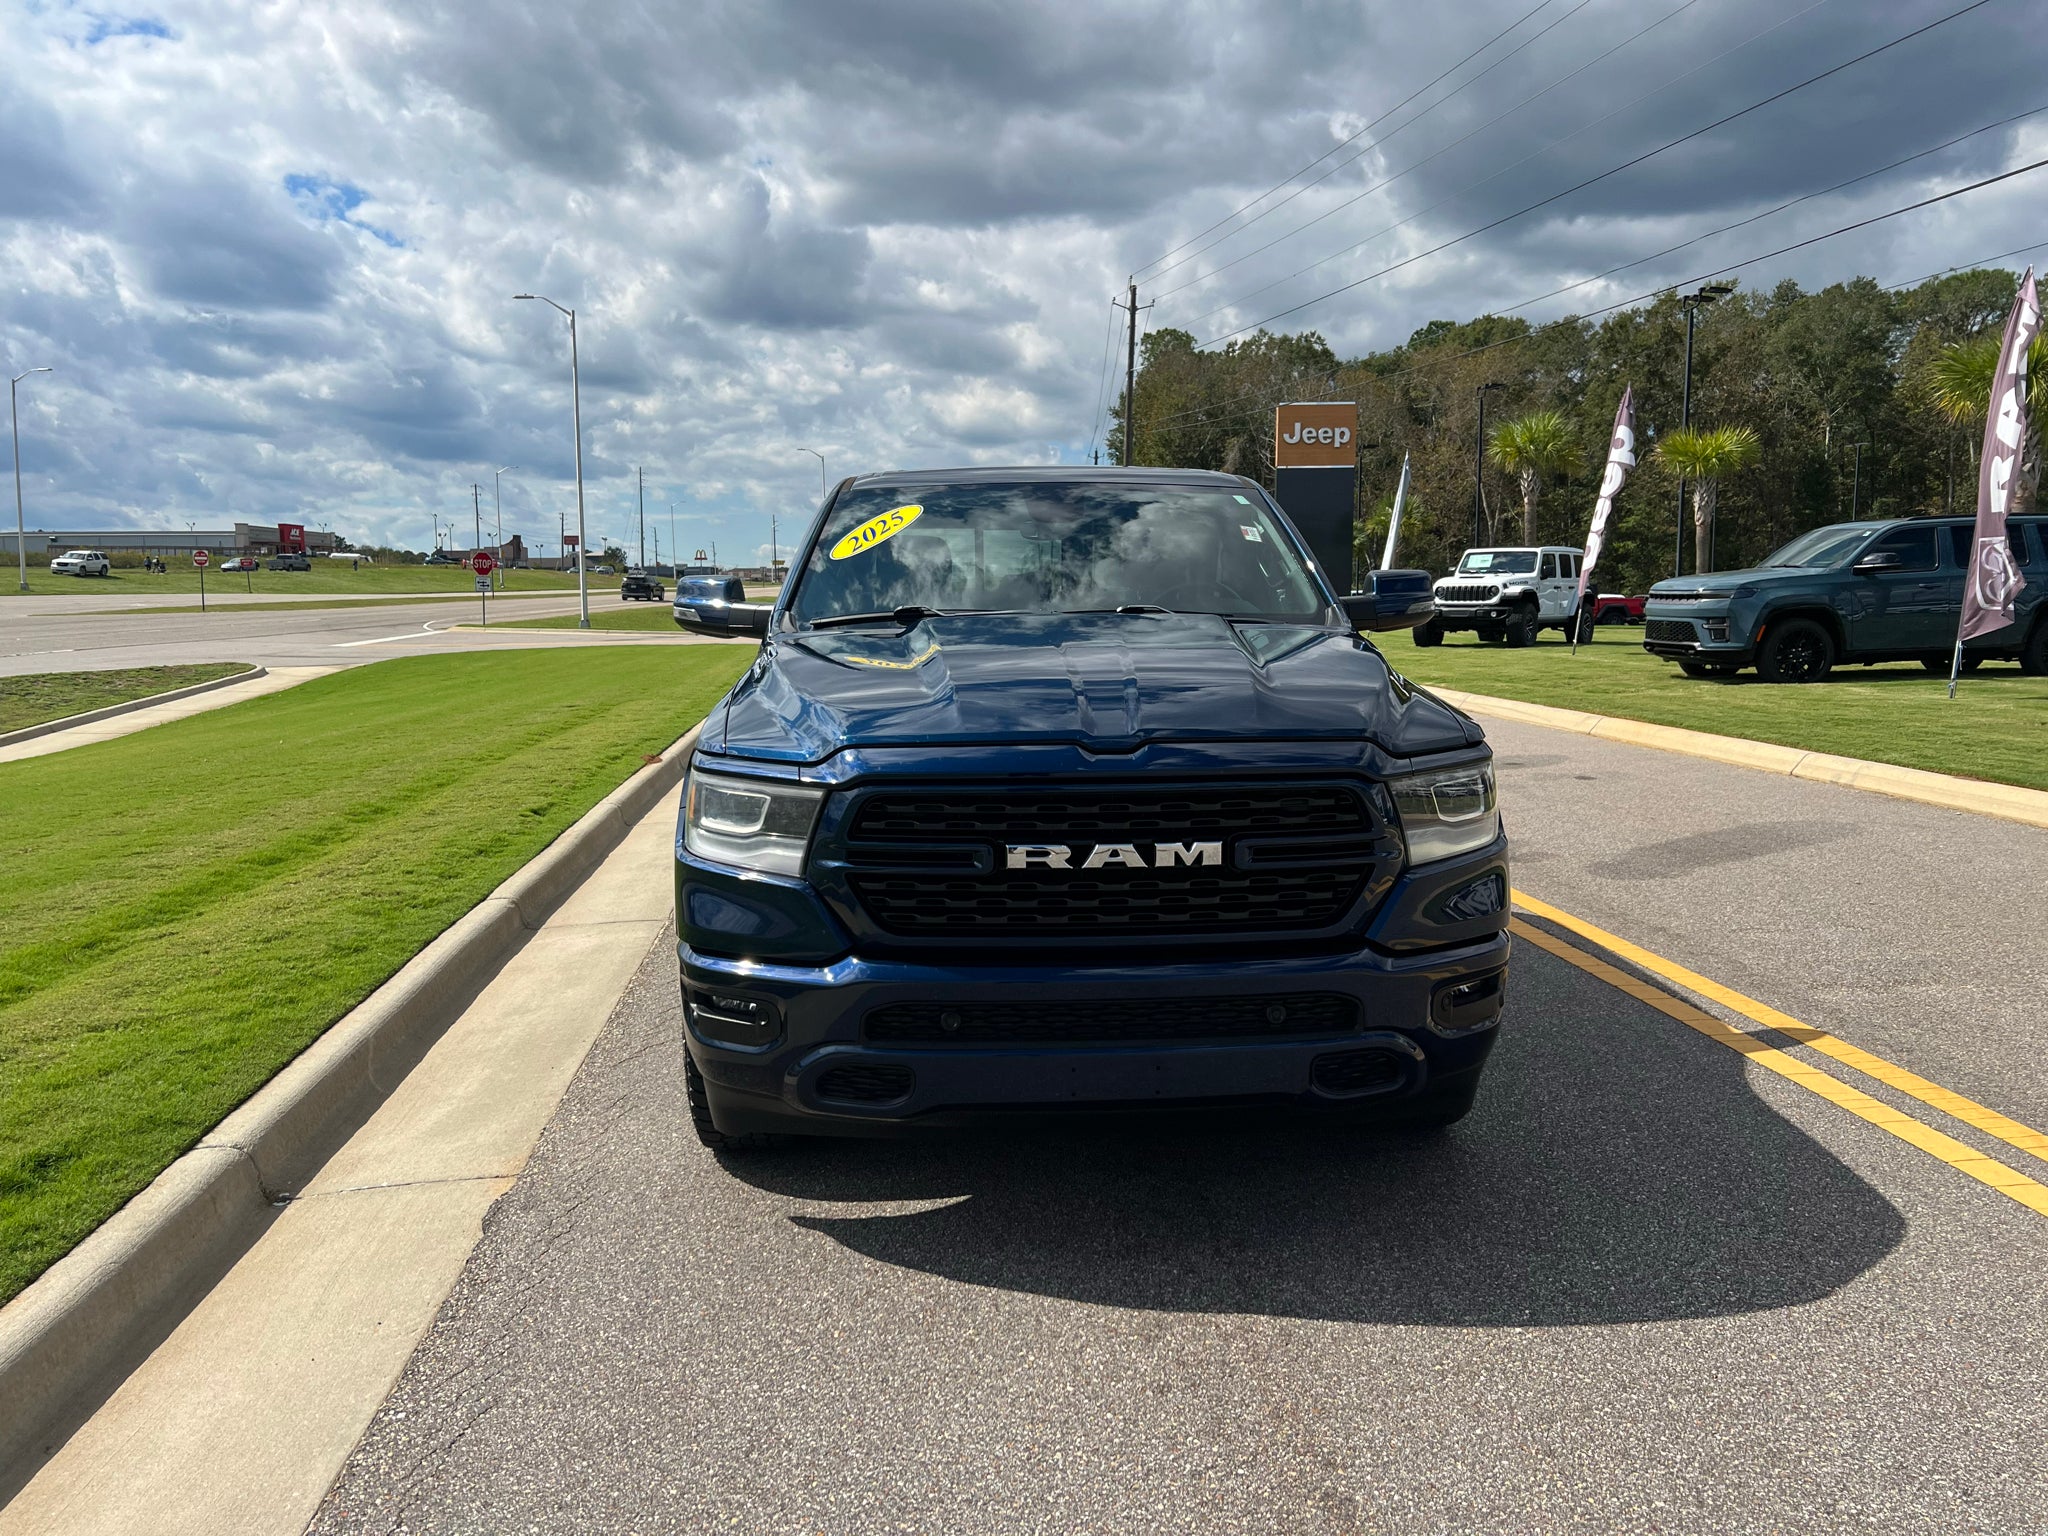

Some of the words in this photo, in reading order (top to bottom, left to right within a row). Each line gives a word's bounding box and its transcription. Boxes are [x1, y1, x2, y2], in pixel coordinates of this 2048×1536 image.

[1283, 422, 1351, 448] Jeep
[847, 510, 904, 553] 2025
[474, 559, 492, 569] STOP
[1006, 841, 1223, 869] RAM
